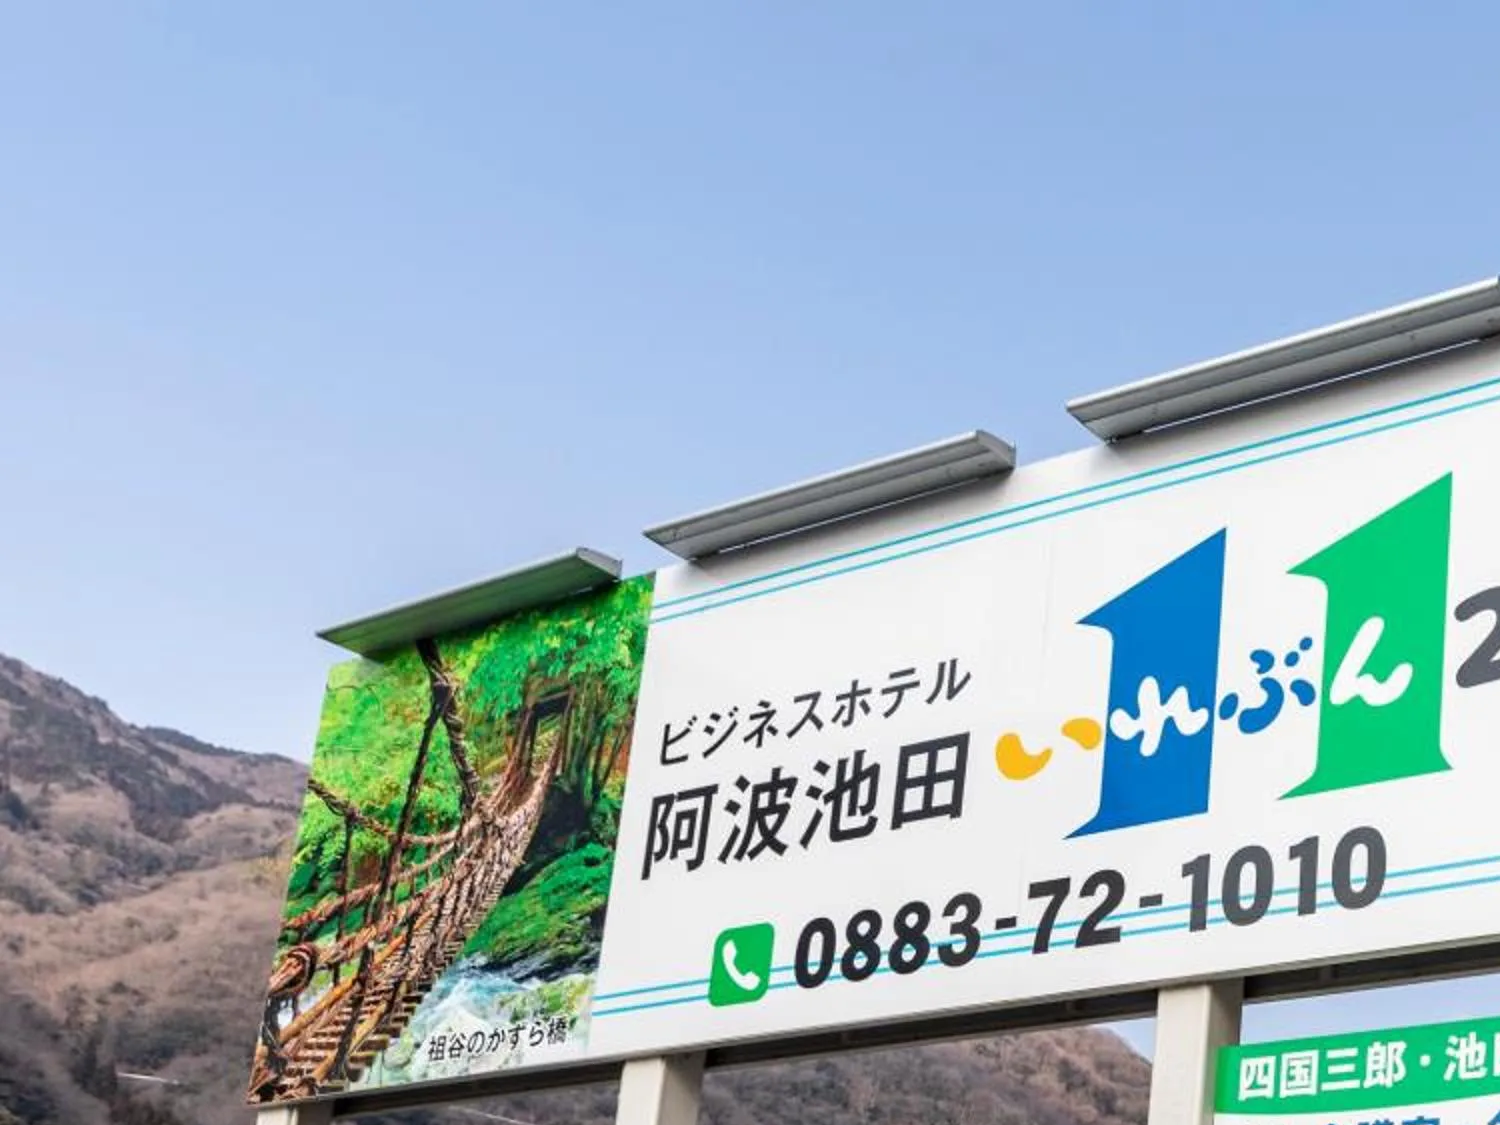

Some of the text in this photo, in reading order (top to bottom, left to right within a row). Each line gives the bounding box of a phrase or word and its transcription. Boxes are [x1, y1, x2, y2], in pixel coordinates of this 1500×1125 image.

[660, 656, 973, 768] ビジネスホテル
[994, 615, 1414, 781] いれぶん
[641, 732, 971, 880] 阿波池田
[792, 824, 1388, 990] 0883-72-1010
